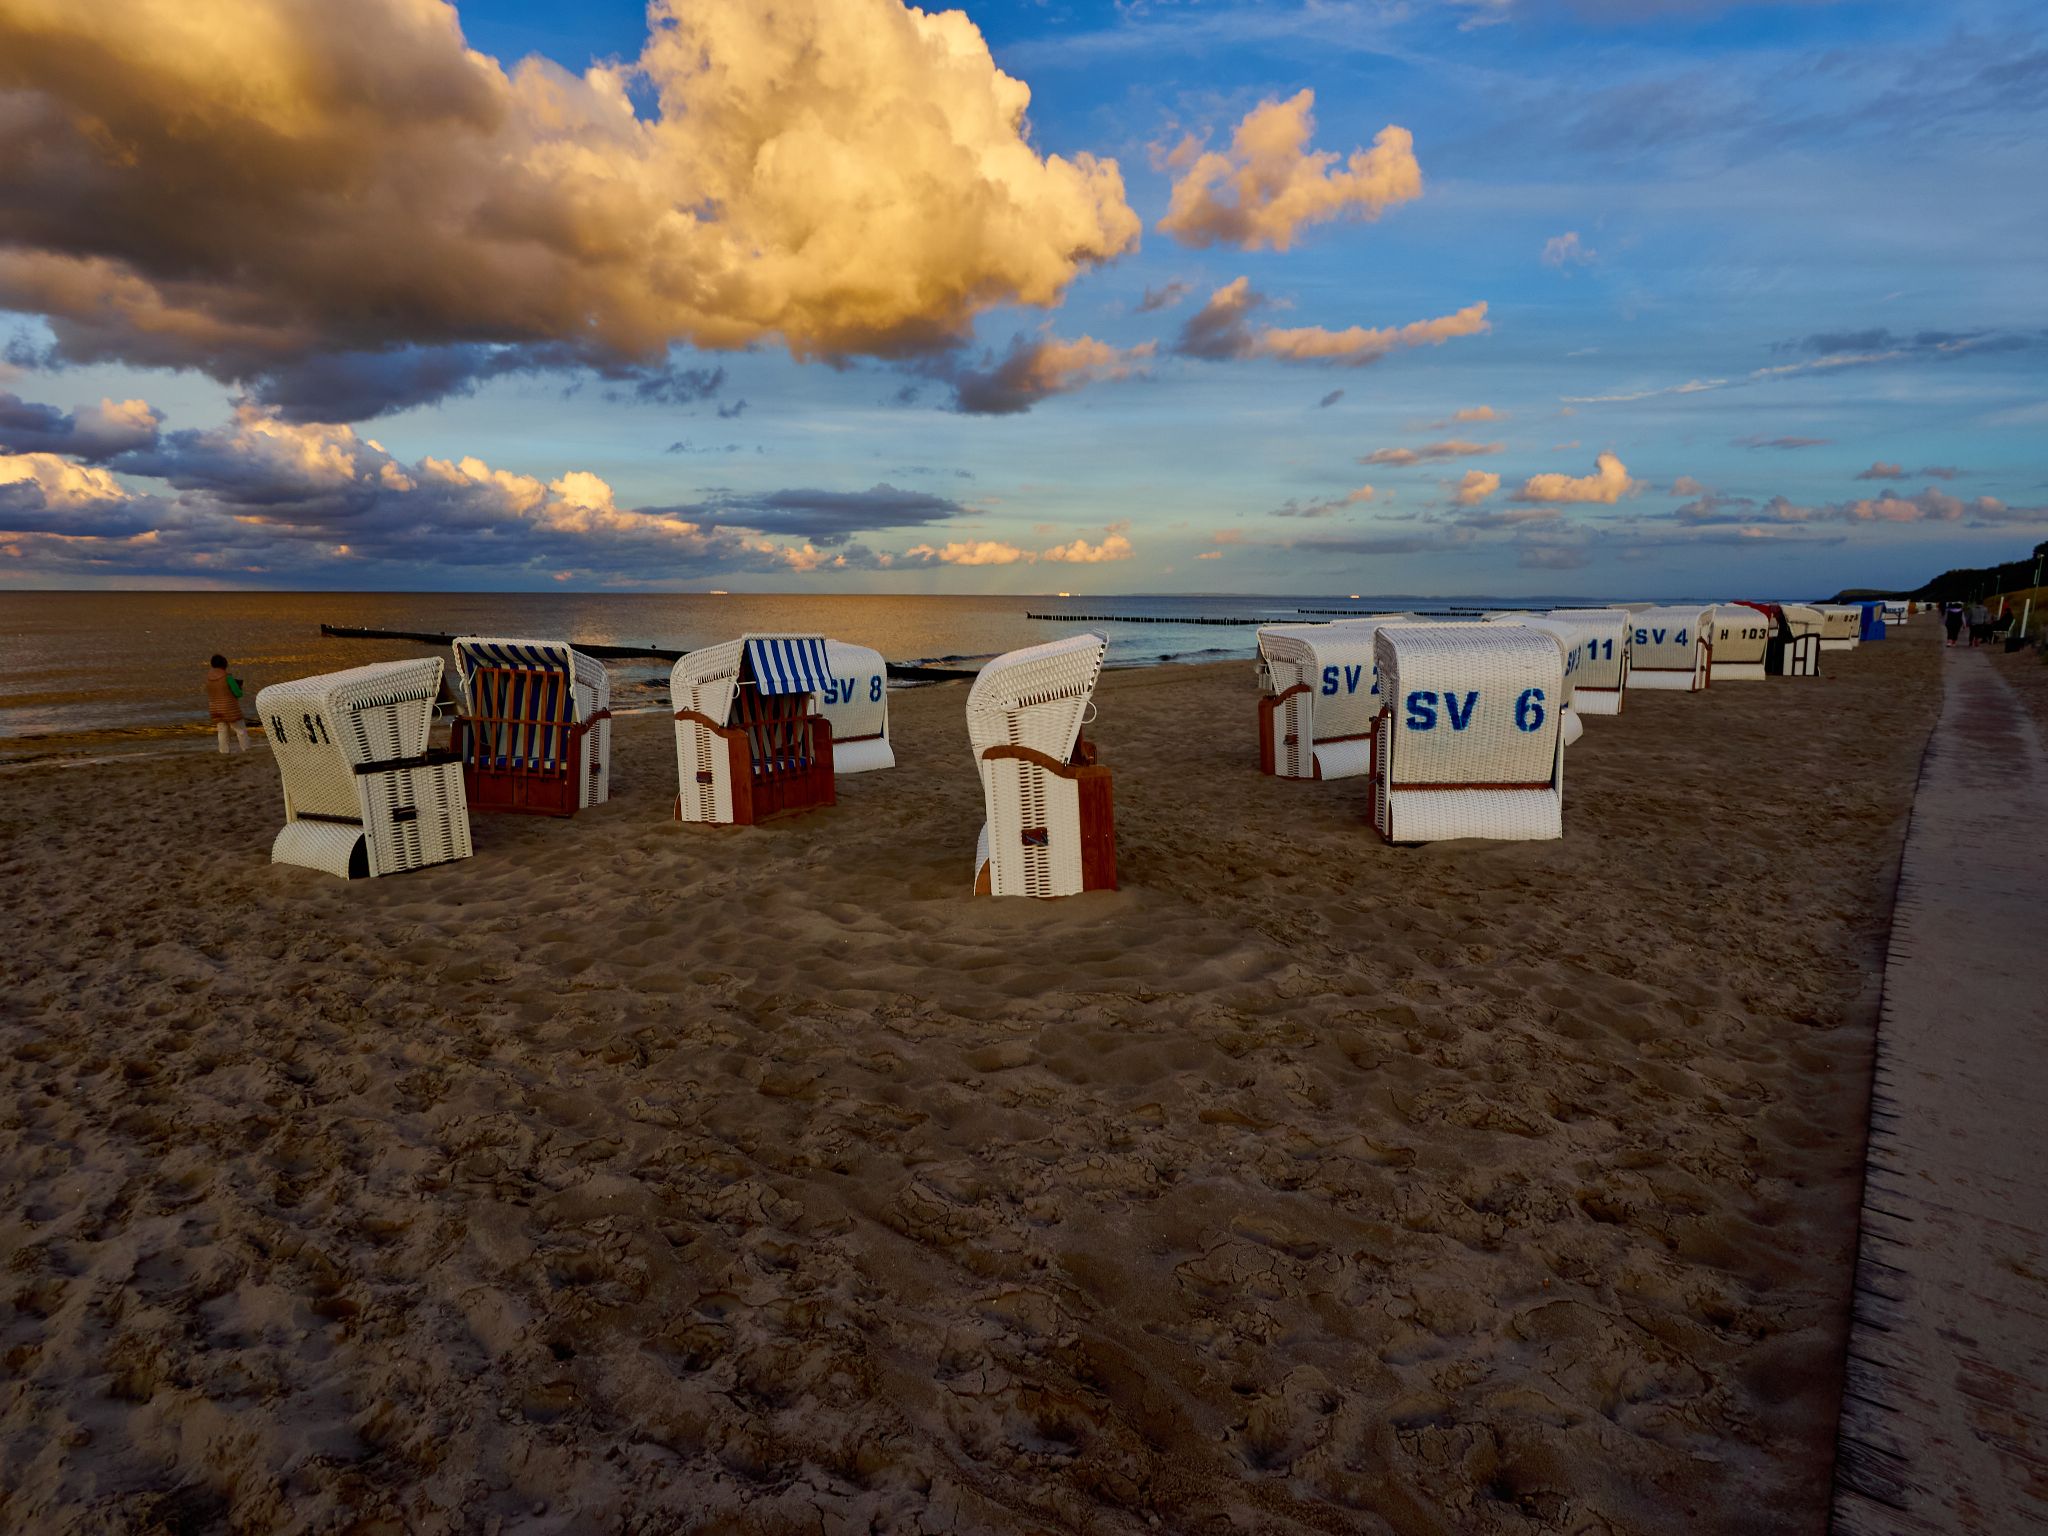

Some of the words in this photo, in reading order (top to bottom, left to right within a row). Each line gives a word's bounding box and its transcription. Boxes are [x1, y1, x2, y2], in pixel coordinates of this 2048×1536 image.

[1635, 629, 1666, 645] SV
[1674, 628, 1689, 646] 4
[1720, 629, 1729, 640] H
[1741, 628, 1767, 640] 103
[1587, 638, 1613, 661] 11
[824, 678, 855, 704] SV
[869, 675, 882, 702] 8
[1322, 664, 1362, 695] SV
[1405, 690, 1479, 731] SV
[1514, 688, 1545, 732] 6
[271, 714, 288, 744] H
[303, 713, 330, 745] 91
